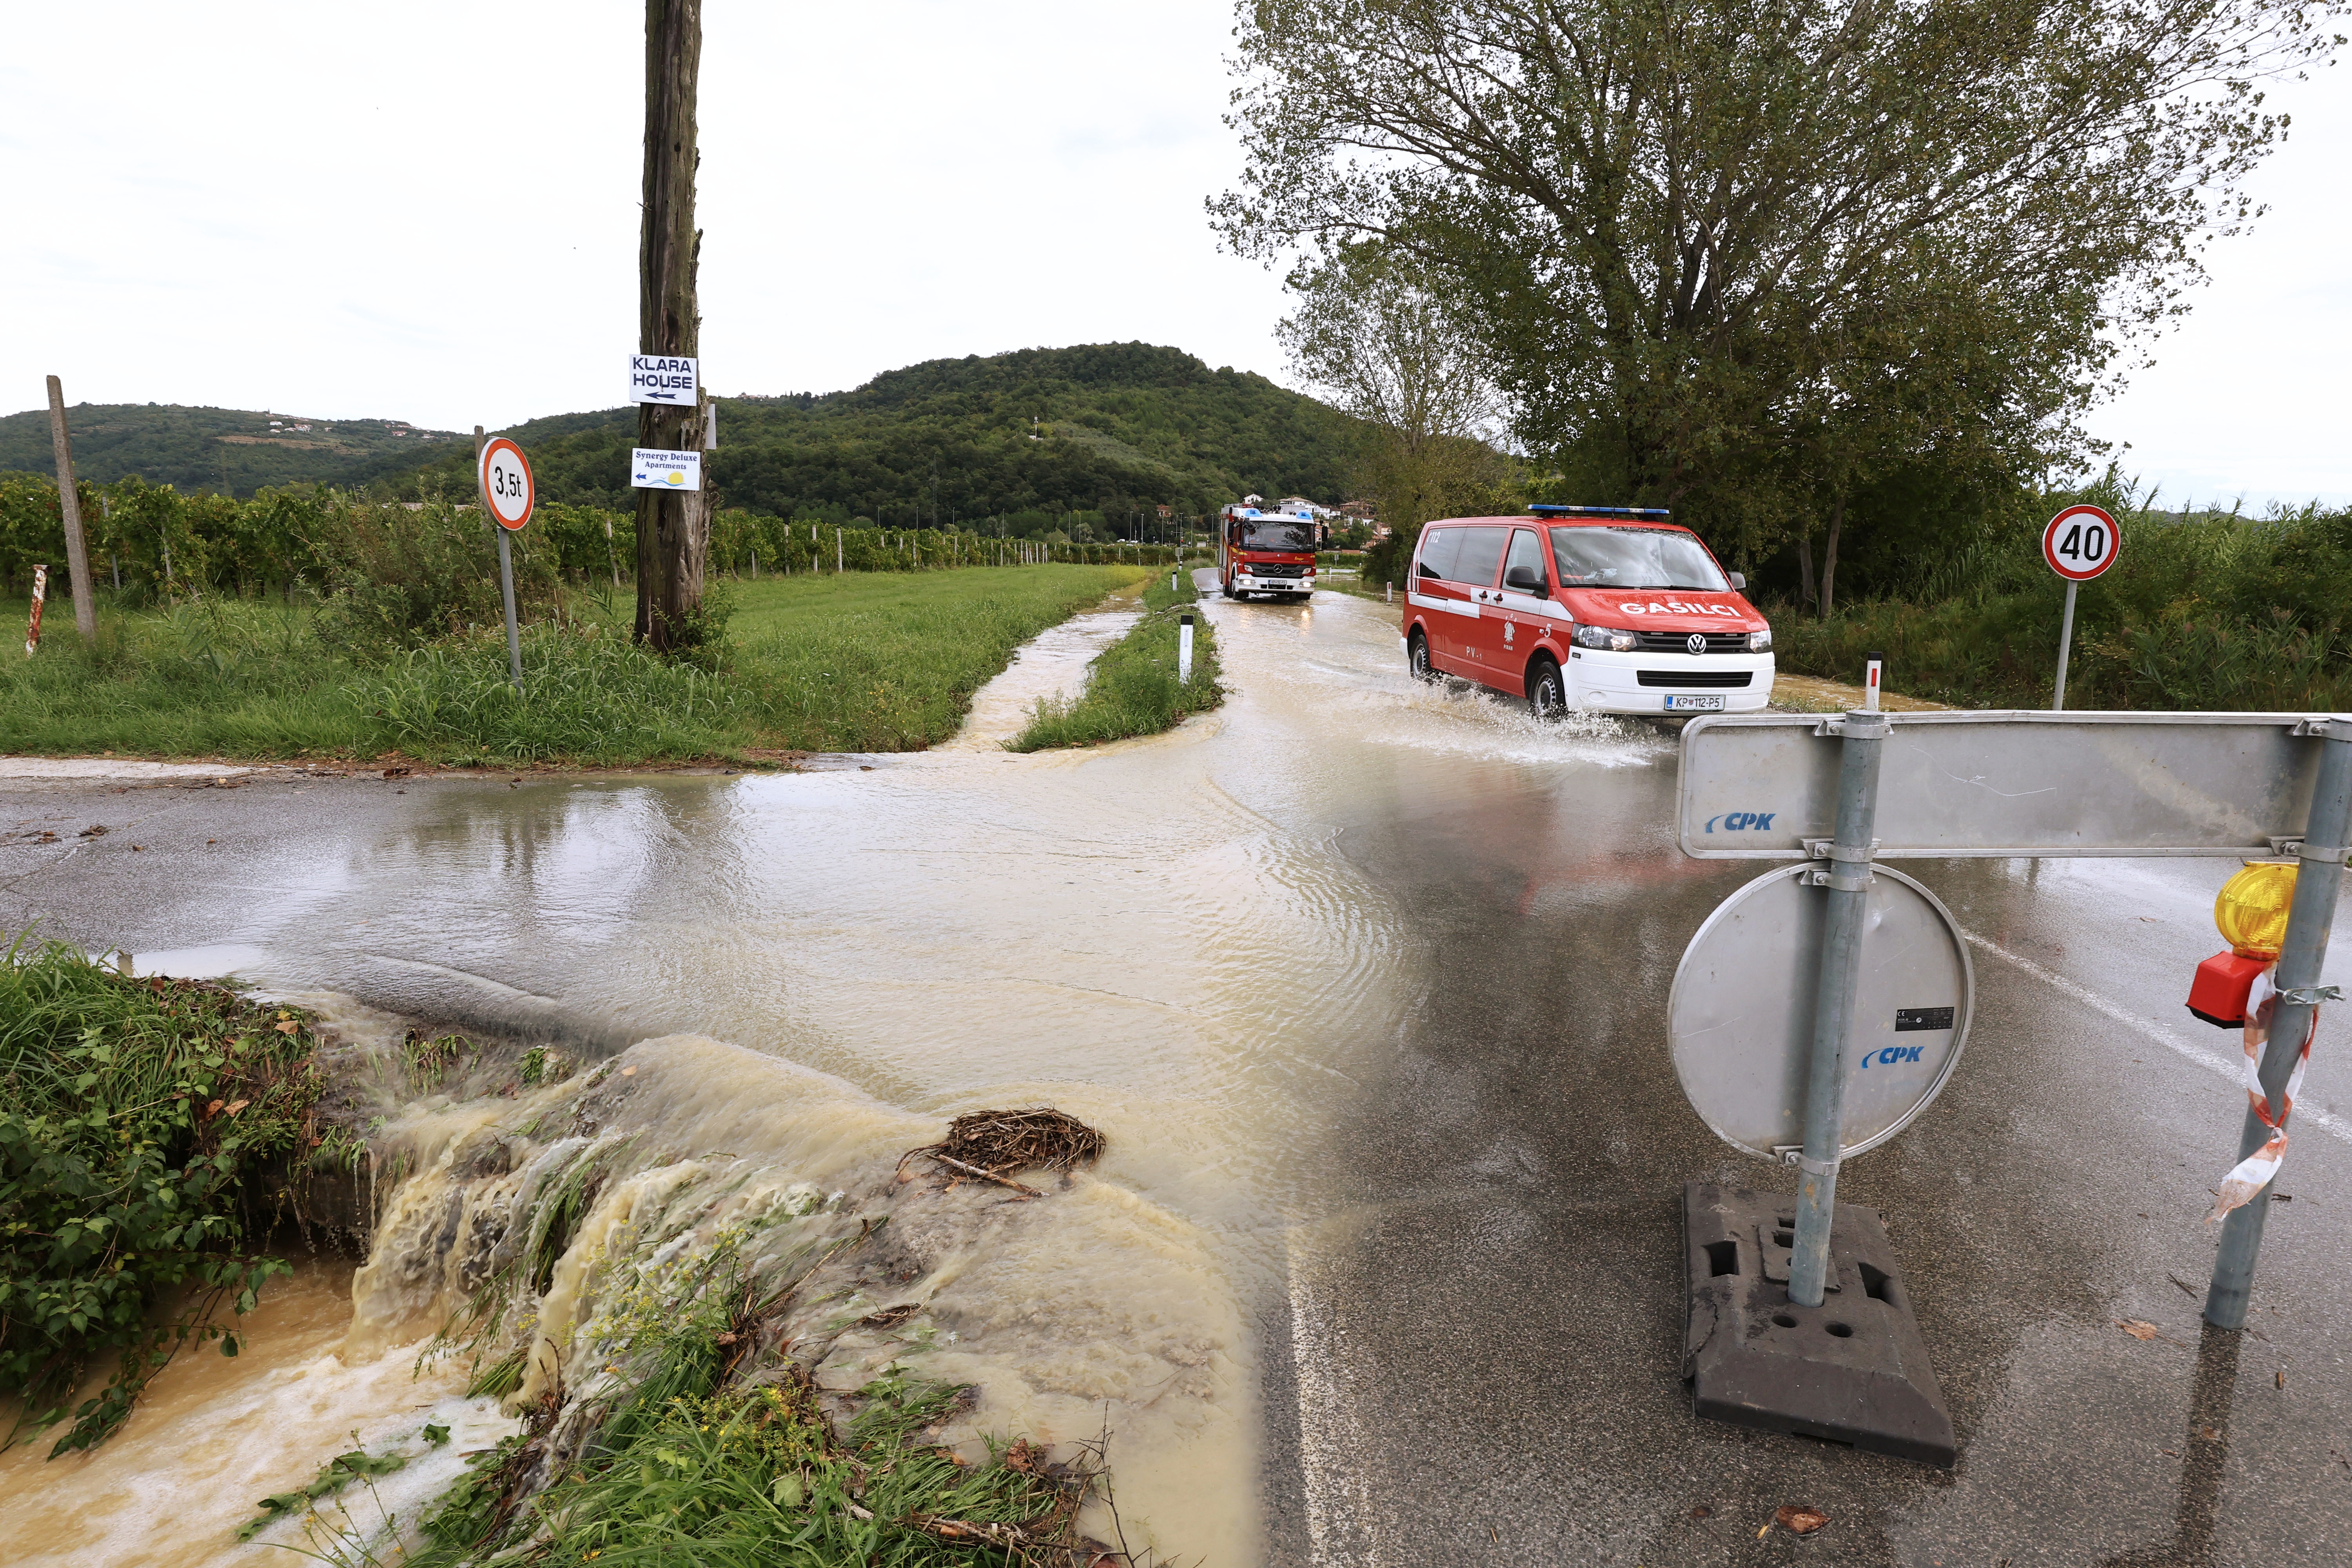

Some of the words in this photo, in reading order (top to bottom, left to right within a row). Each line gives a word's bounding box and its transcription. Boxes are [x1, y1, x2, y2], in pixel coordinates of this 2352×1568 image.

[633, 357, 691, 373] KLARA
[633, 374, 692, 389] HOUSE
[636, 451, 668, 461] Synergy
[671, 453, 697, 461] Deluxe
[645, 461, 686, 470] Apartments
[495, 466, 522, 499] 3,5t
[1430, 531, 1441, 543] 112
[2060, 525, 2104, 561] 40
[1619, 602, 1742, 617] GASILCI
[1544, 623, 1552, 638] 5
[1676, 697, 1688, 707] KP
[1694, 697, 1720, 707] 112-P5
[1723, 812, 1777, 831] CPK
[1879, 1045, 1925, 1065] CPK
